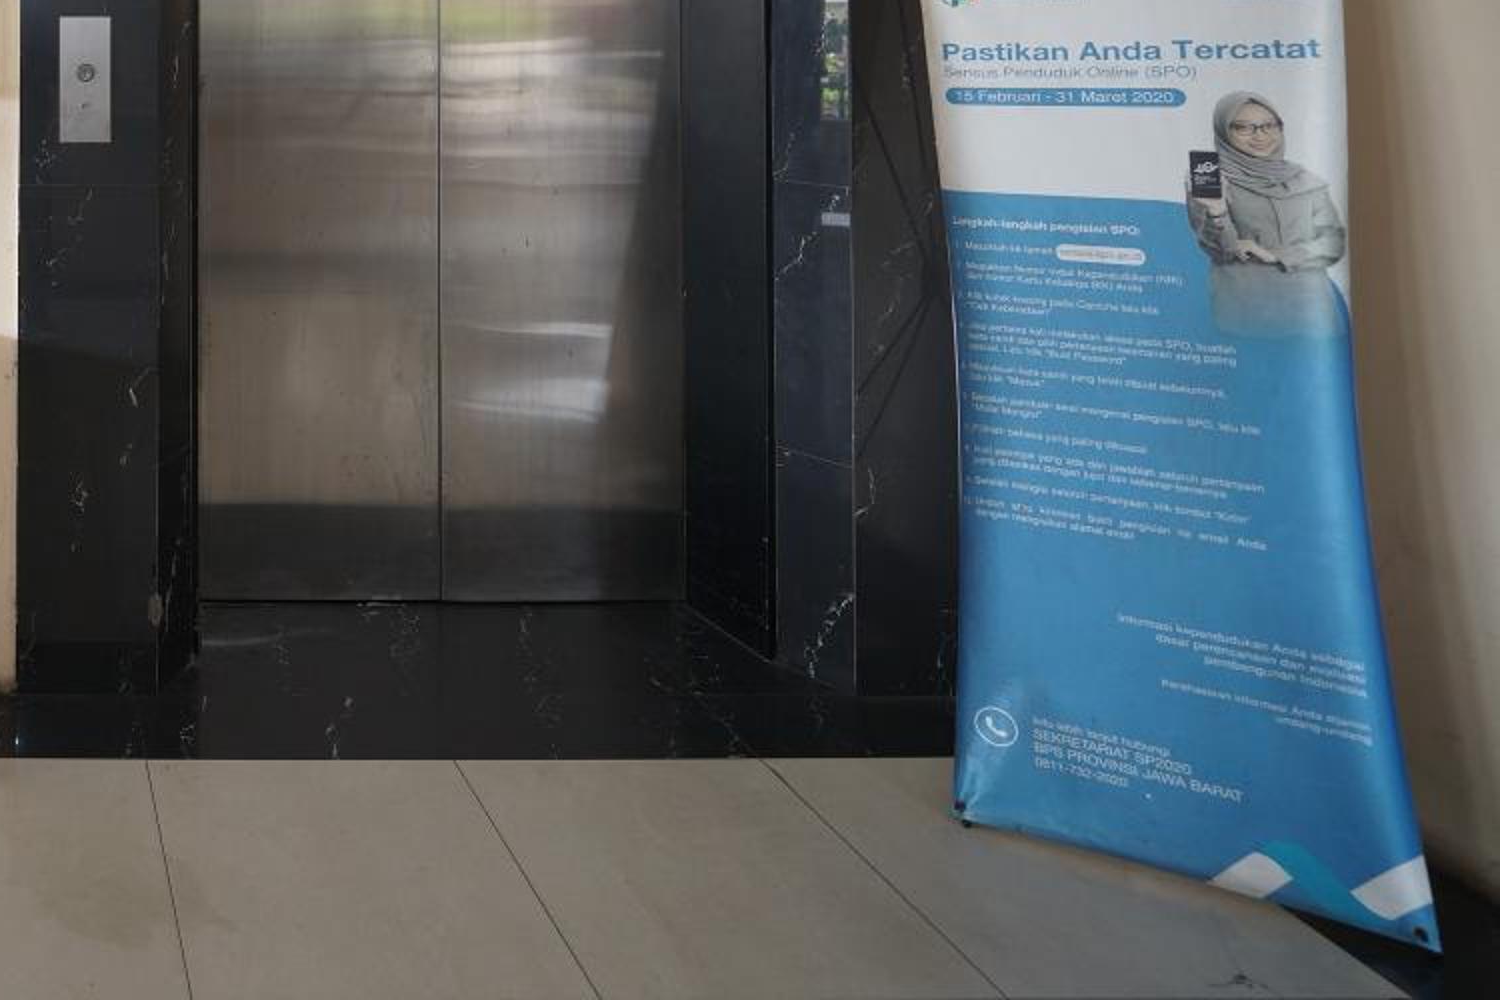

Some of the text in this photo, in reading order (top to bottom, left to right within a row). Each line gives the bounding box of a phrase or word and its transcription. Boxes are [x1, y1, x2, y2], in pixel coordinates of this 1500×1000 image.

[942, 39, 1321, 62] Pastikan Anda Tercatat
[944, 65, 1197, 79] Sensus Penduduk Online (SPO)
[956, 90, 974, 102] 15
[978, 90, 1042, 102] Februari
[1056, 91, 1073, 103] 31
[1081, 91, 1128, 103] Maret
[1133, 91, 1174, 103] 2020
[1033, 728, 1129, 760] SEKRETARIAT
[1066, 749, 1139, 778] PROVINSI
[1141, 768, 1187, 789] JAWA
[1190, 778, 1244, 803] BARAT
